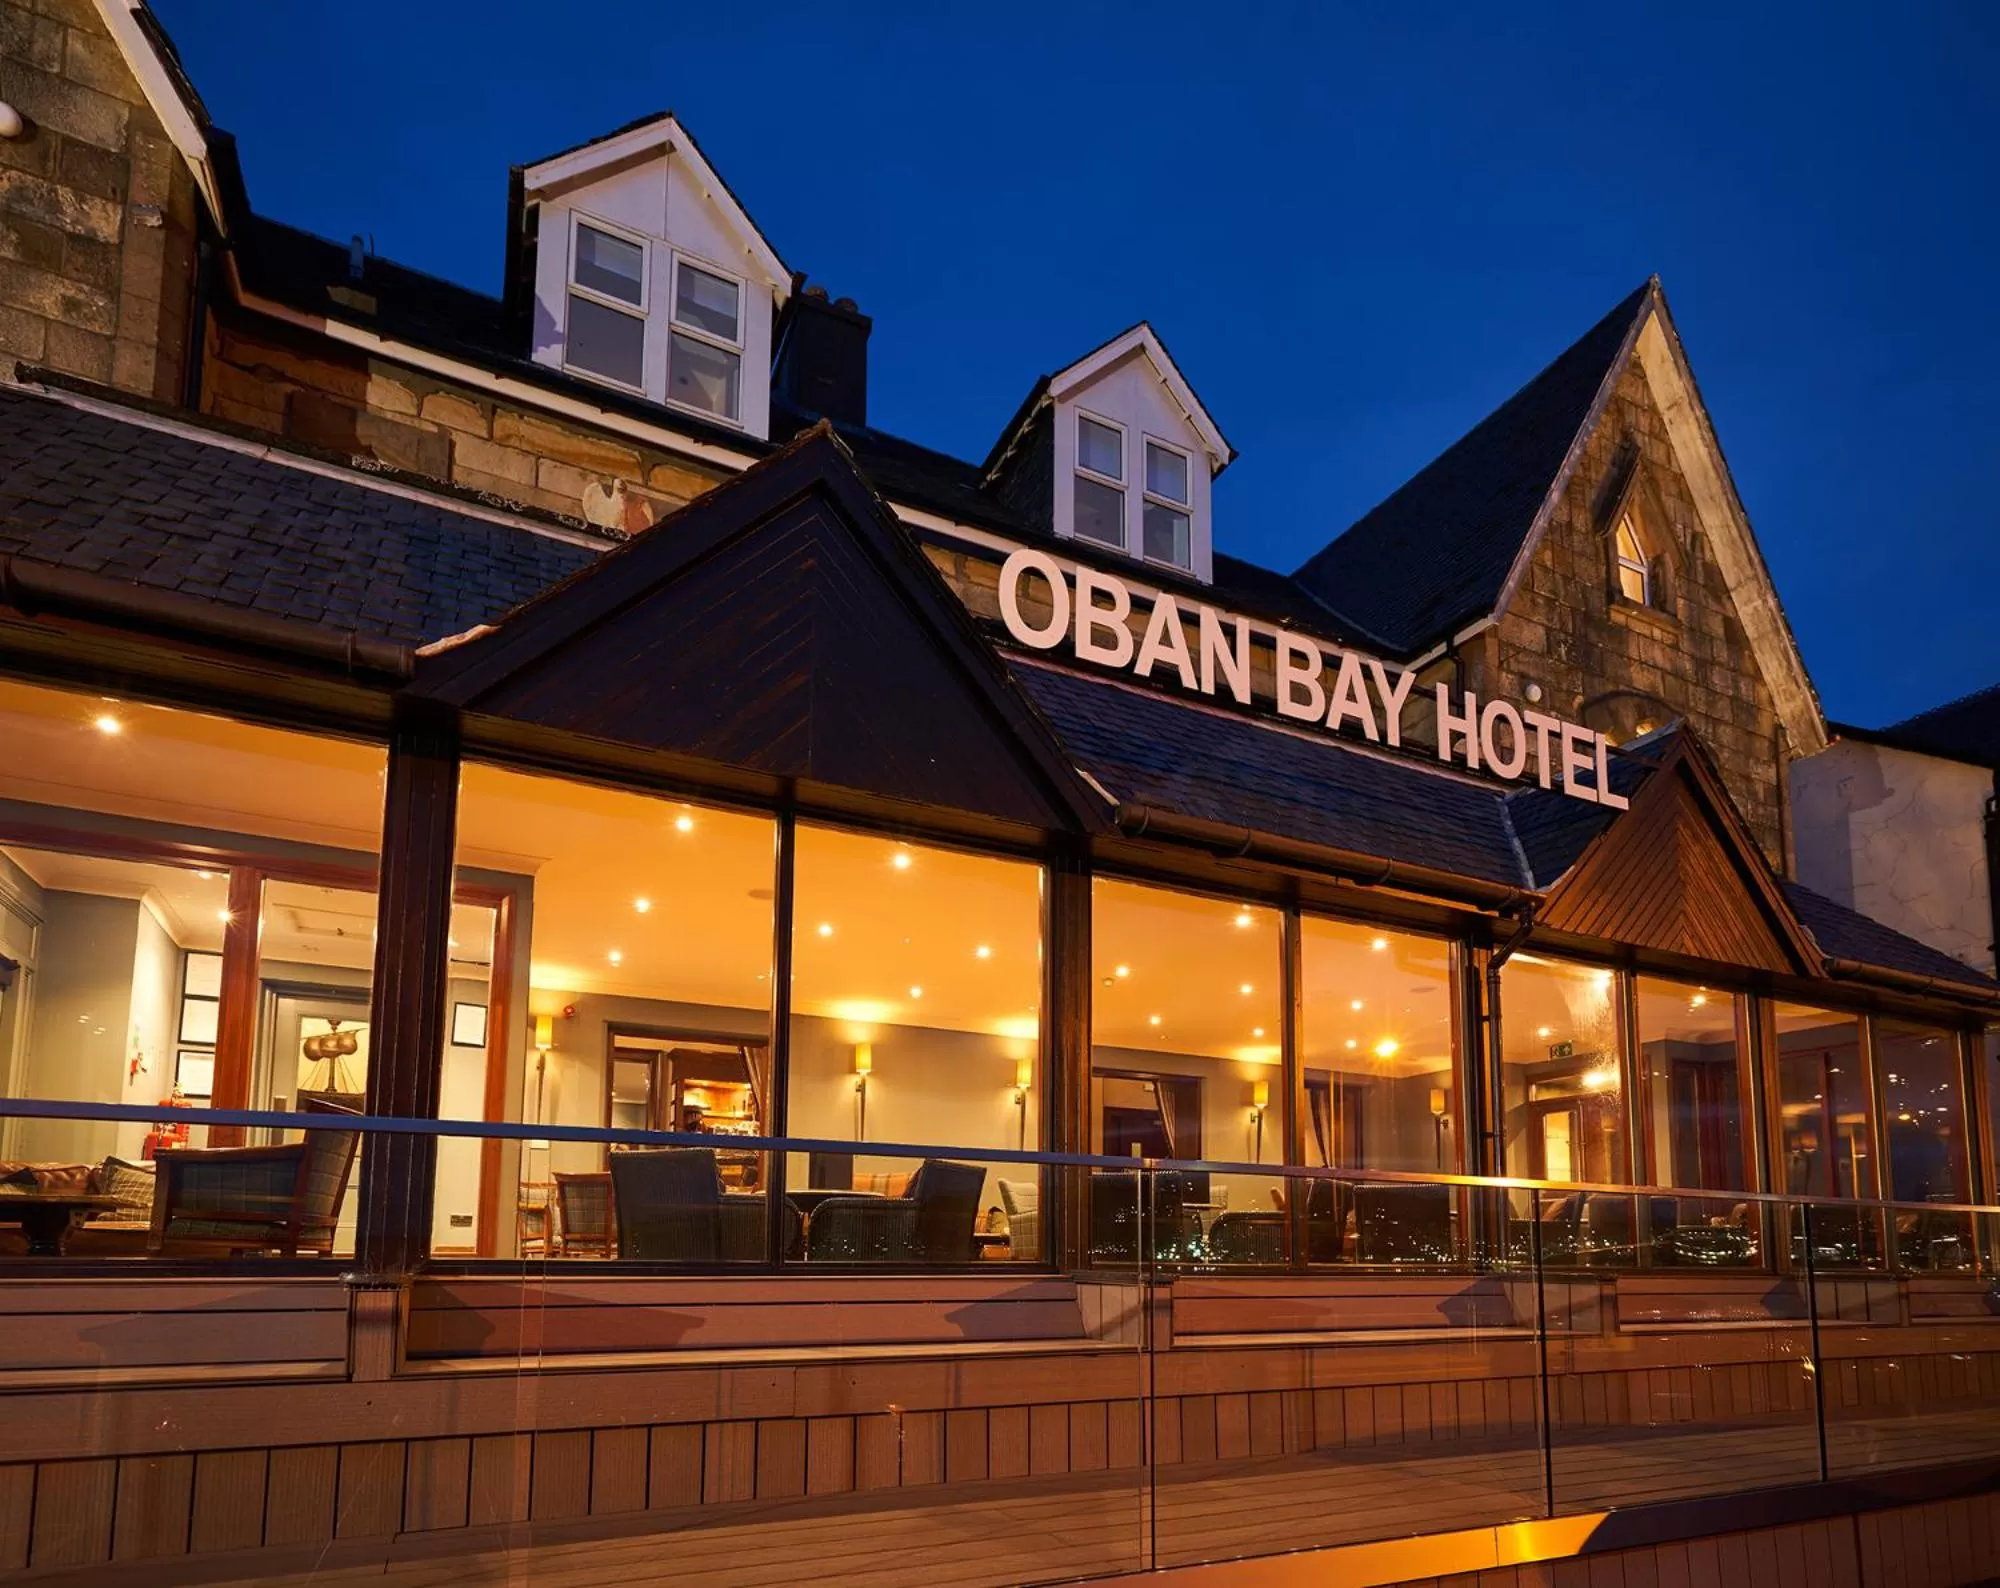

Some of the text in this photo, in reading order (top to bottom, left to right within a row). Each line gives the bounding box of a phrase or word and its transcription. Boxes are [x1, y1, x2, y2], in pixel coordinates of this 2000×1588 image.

[998, 548, 1629, 810] OBAN BAY HOTEL
